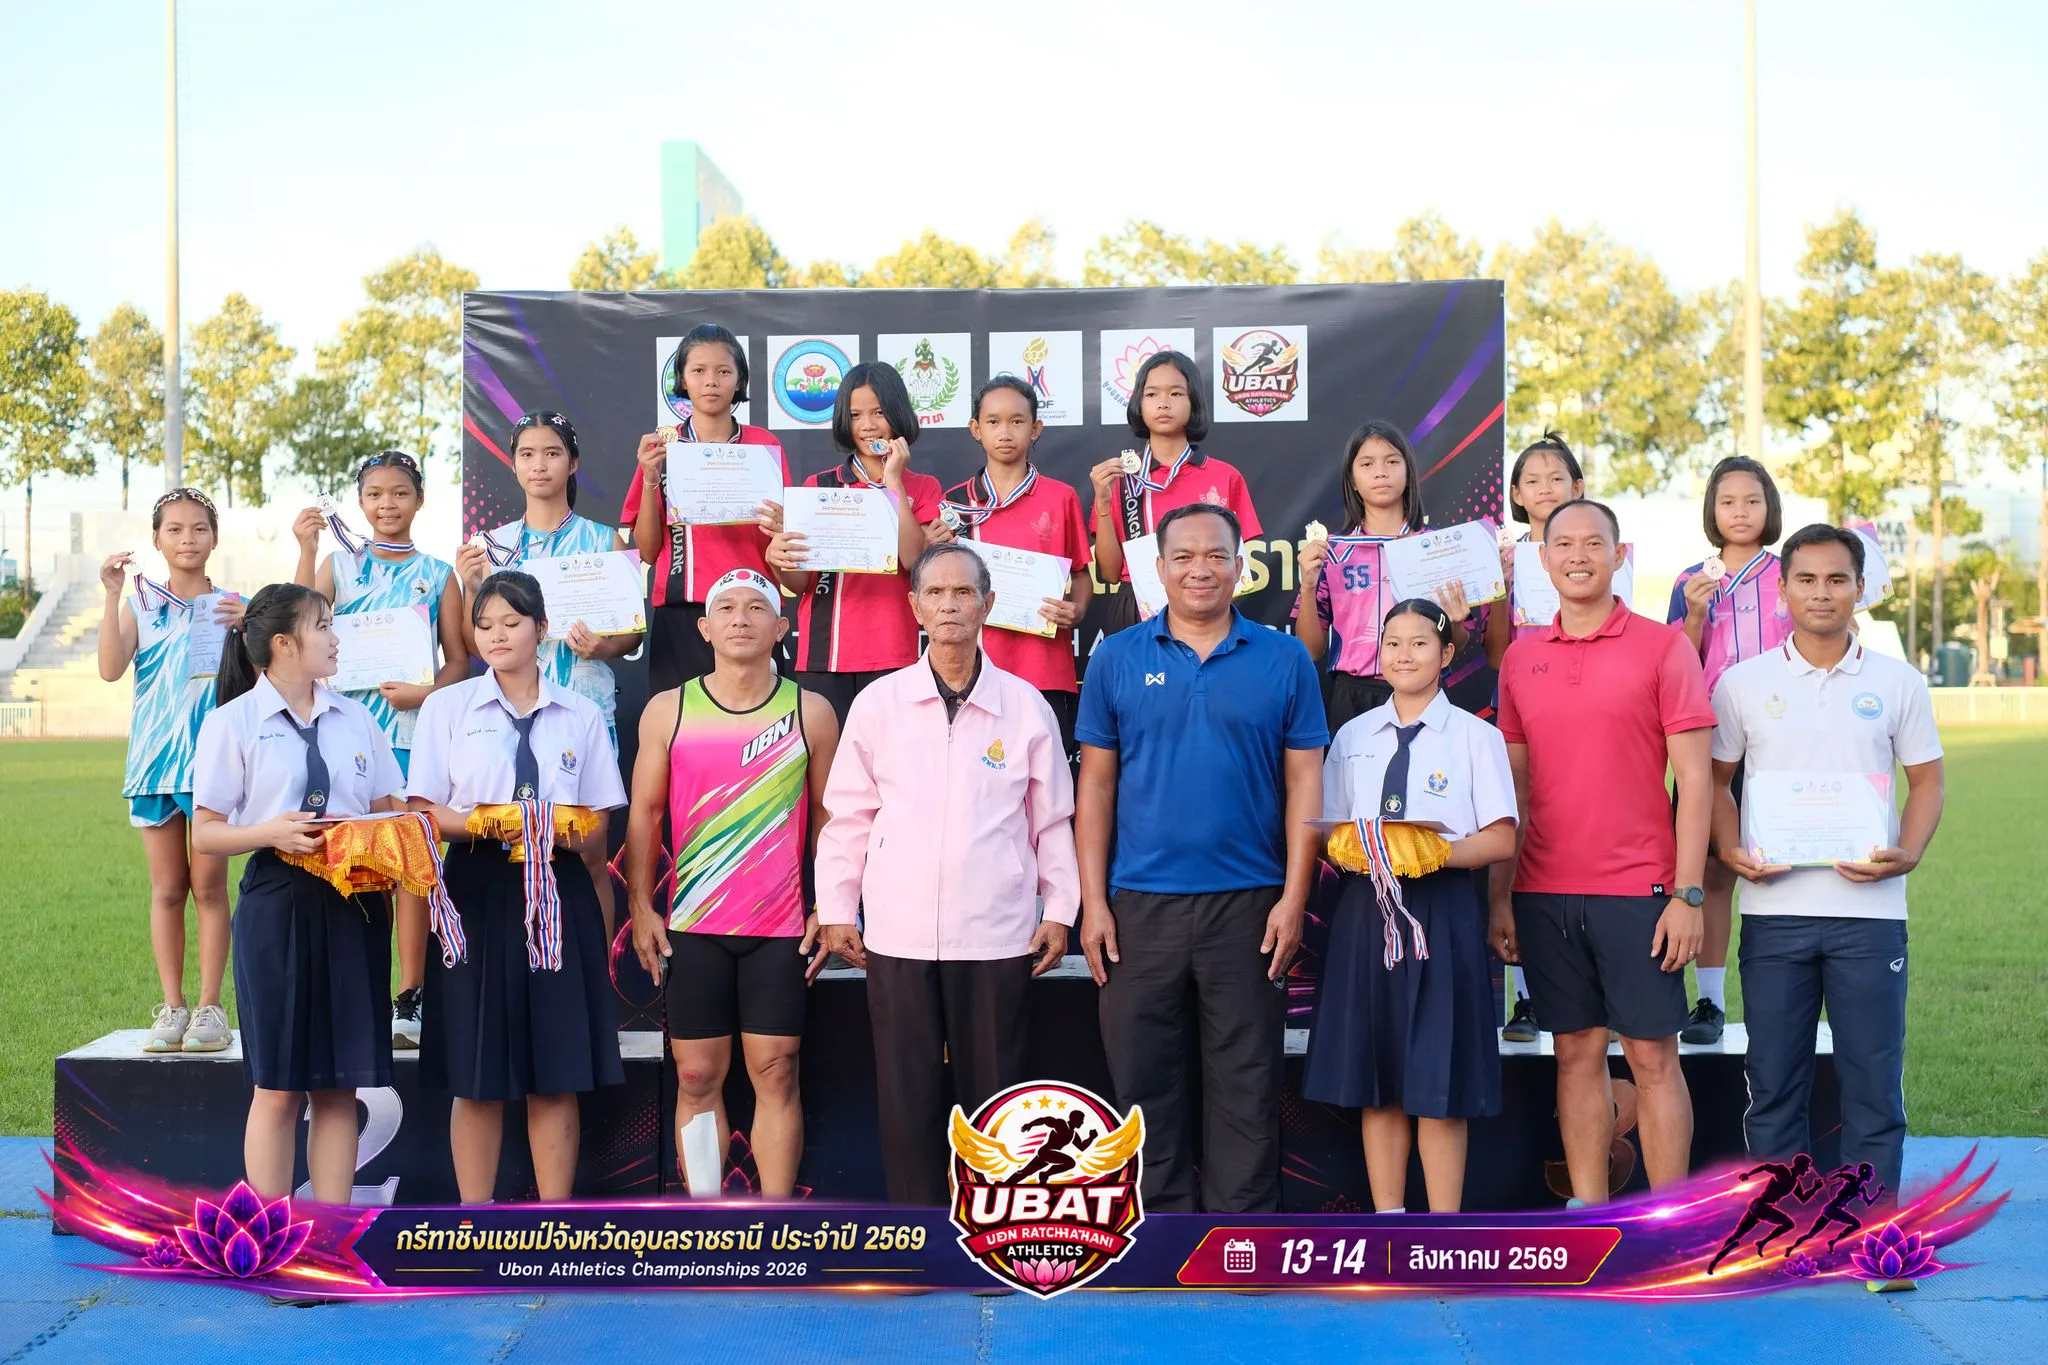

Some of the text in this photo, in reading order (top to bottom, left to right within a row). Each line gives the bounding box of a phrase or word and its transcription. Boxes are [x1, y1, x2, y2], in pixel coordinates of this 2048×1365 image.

[1228, 374, 1292, 392] UBAT
[1037, 400, 1055, 409] DF
[740, 711, 794, 768] UBN
[295, 1085, 404, 1208] 2
